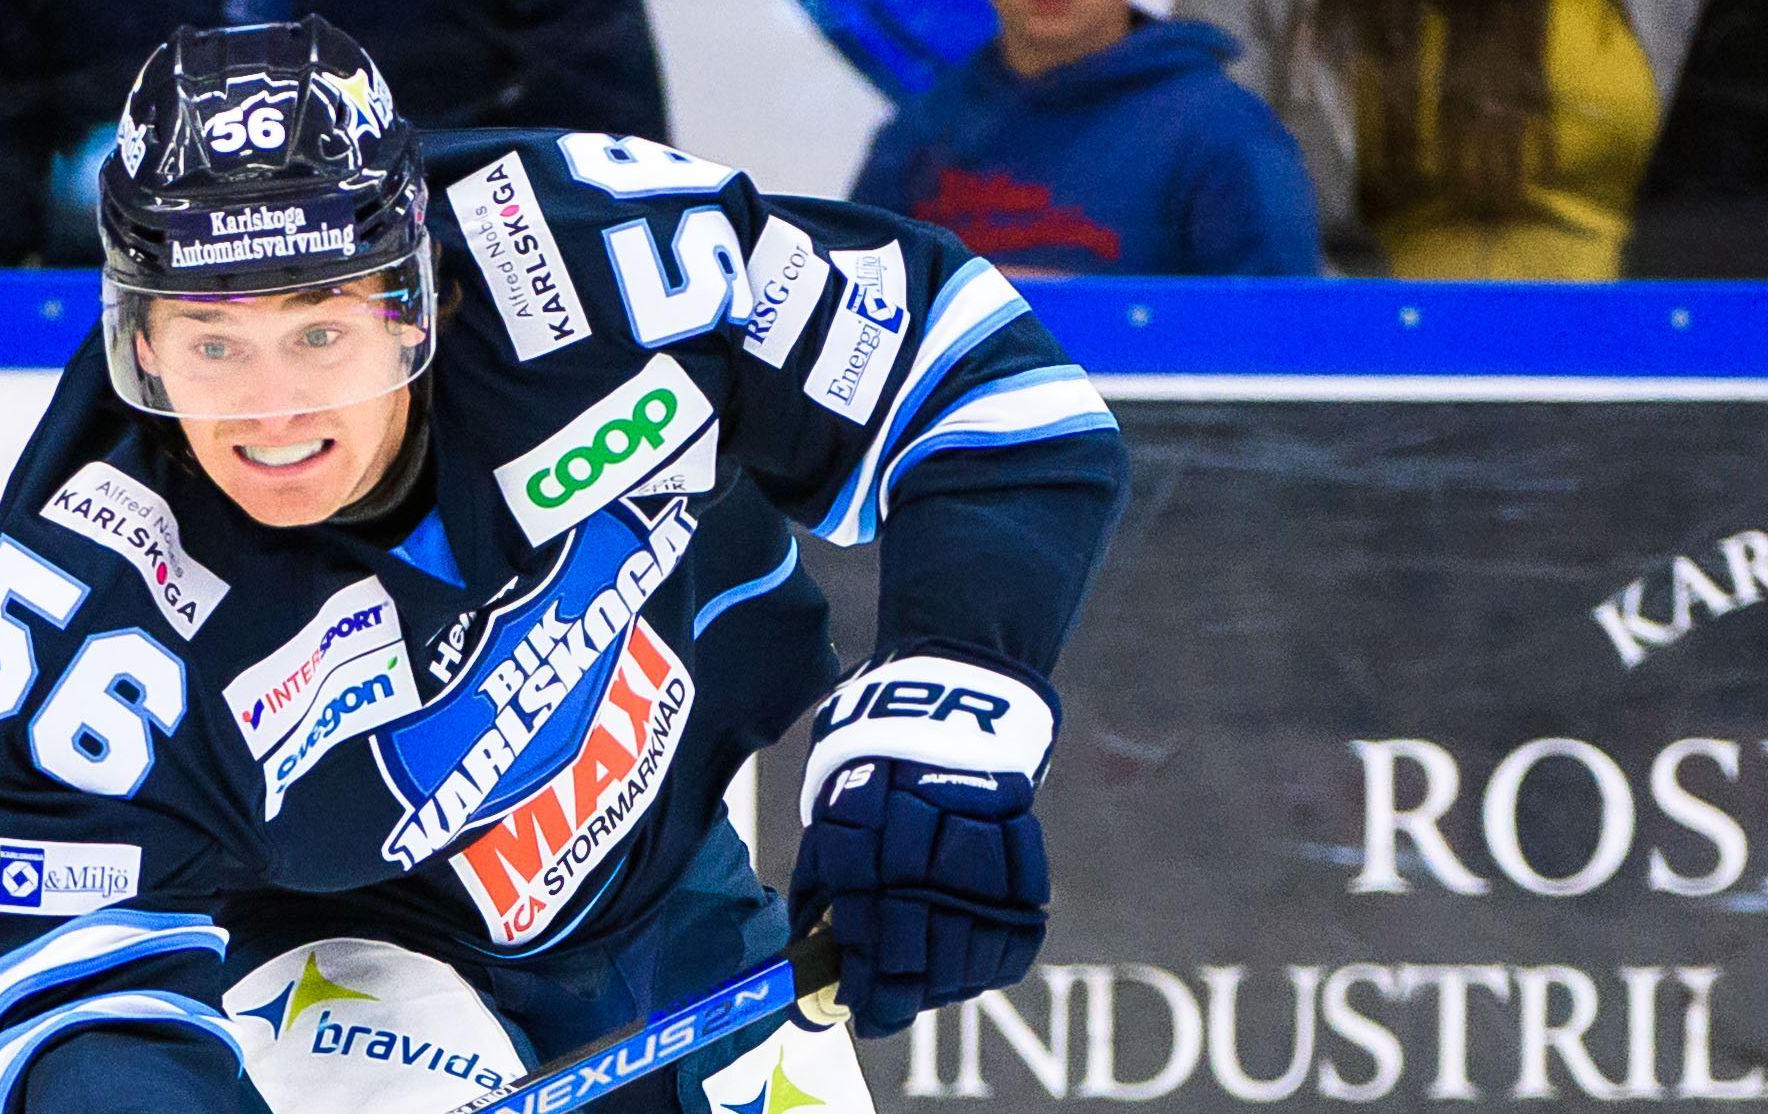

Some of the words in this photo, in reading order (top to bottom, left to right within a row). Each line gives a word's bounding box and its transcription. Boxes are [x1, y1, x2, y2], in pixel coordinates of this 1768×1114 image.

[209, 107, 286, 153] 56
[171, 222, 357, 269] Automatsvarvning
[210, 206, 307, 237] Karlskoga
[475, 206, 505, 259] Nobls
[497, 261, 534, 318] Alfred
[745, 280, 789, 345] RSG
[827, 318, 883, 407] Energi
[526, 388, 678, 509] coop
[95, 480, 155, 519] Alfred
[1590, 528, 1768, 670] KAR
[385, 503, 694, 867] KARLSKOGA
[478, 599, 577, 714] BIK
[462, 624, 672, 918] MAXI
[503, 894, 546, 941] ICA
[543, 678, 686, 896] STORMARKNAD
[1347, 736, 1768, 897] ROS
[64, 865, 129, 898] Miljö
[311, 1010, 503, 1091] bravida
